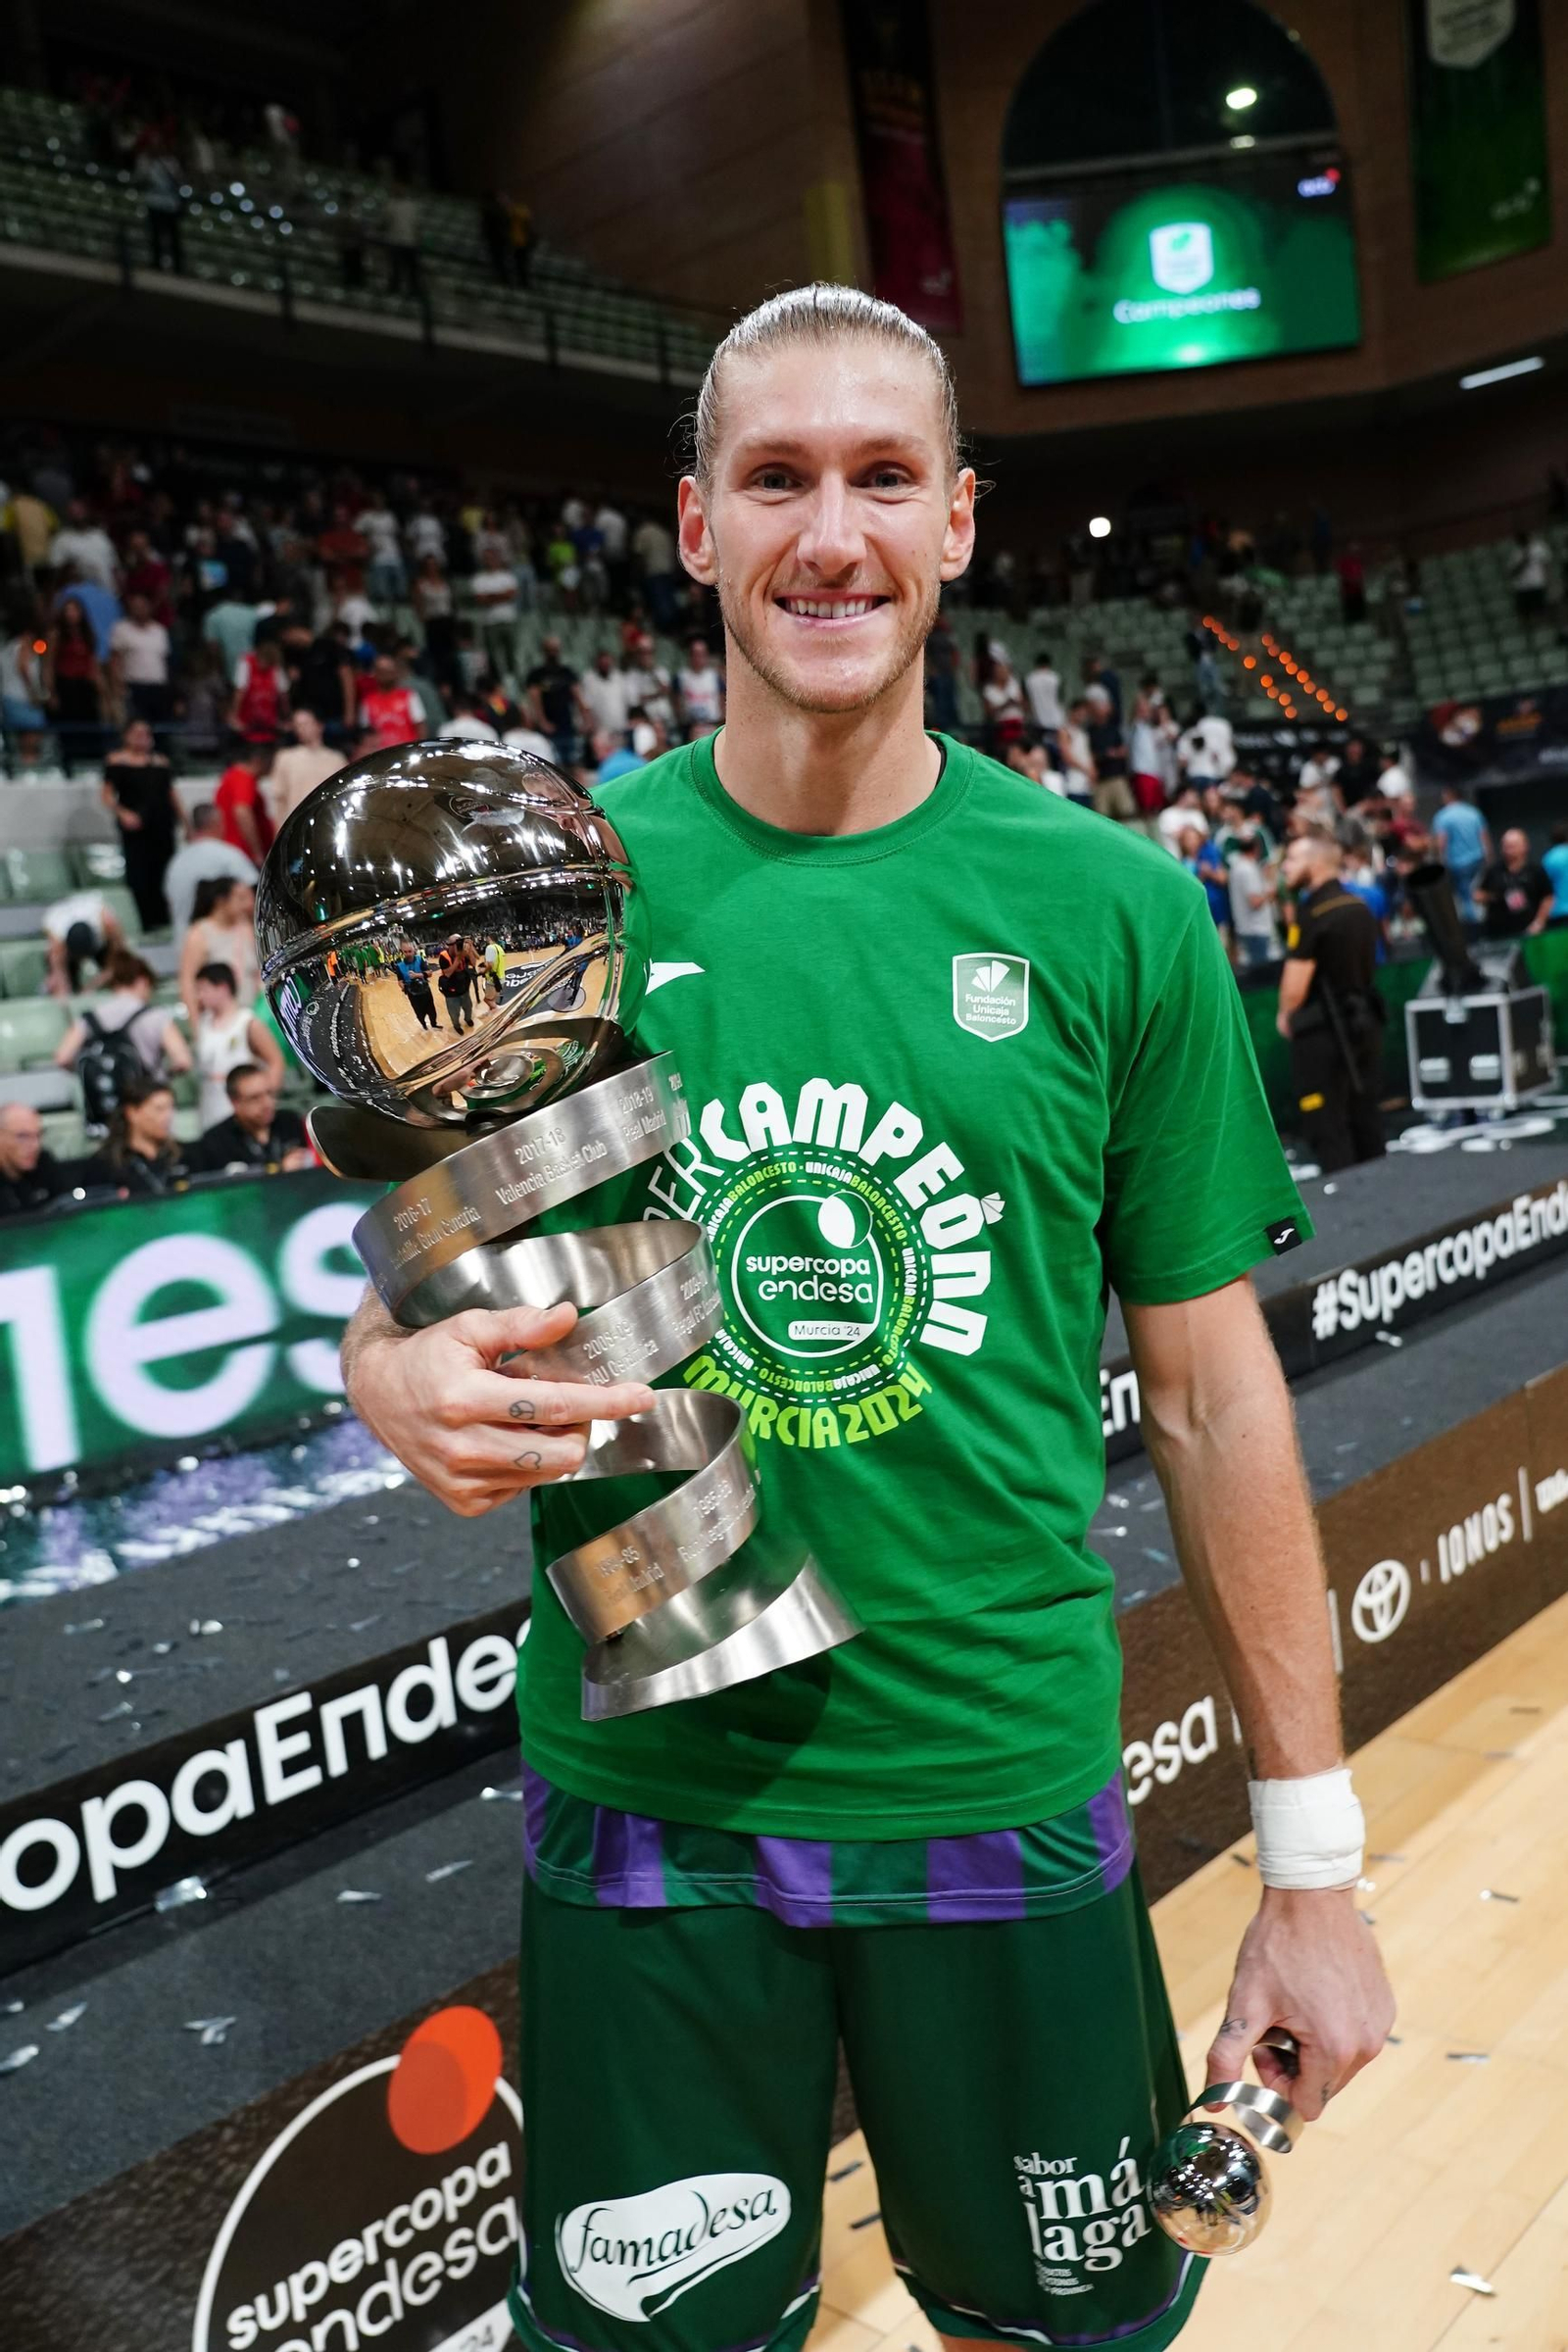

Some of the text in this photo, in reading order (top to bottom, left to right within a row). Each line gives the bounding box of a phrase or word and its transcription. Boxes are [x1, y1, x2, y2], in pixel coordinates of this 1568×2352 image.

[964, 994, 1016, 1006] Fundación
[972, 1004, 1009, 1017] Unicaja
[965, 1013, 1017, 1025] Baloncesto
[514, 1127, 566, 1165] 2017-18
[495, 1140, 608, 1205] Valencia Basket Club
[394, 1198, 432, 1232] 2016-17
[441, 1205, 482, 1247] Canaria
[746, 1254, 870, 1276] supercopa
[758, 1277, 875, 1304] endesa
[794, 1324, 841, 1338] Murcia
[584, 1365, 611, 1388] TAU
[1437, 1493, 1515, 1584] IONOS
[0, 1616, 531, 1911] opaEnde
[1013, 2152, 1078, 2176] sabor
[1034, 2135, 1145, 2220] má
[226, 2140, 512, 2351] supercopa
[567, 2188, 777, 2274] famadesa
[1023, 2201, 1152, 2272] laga
